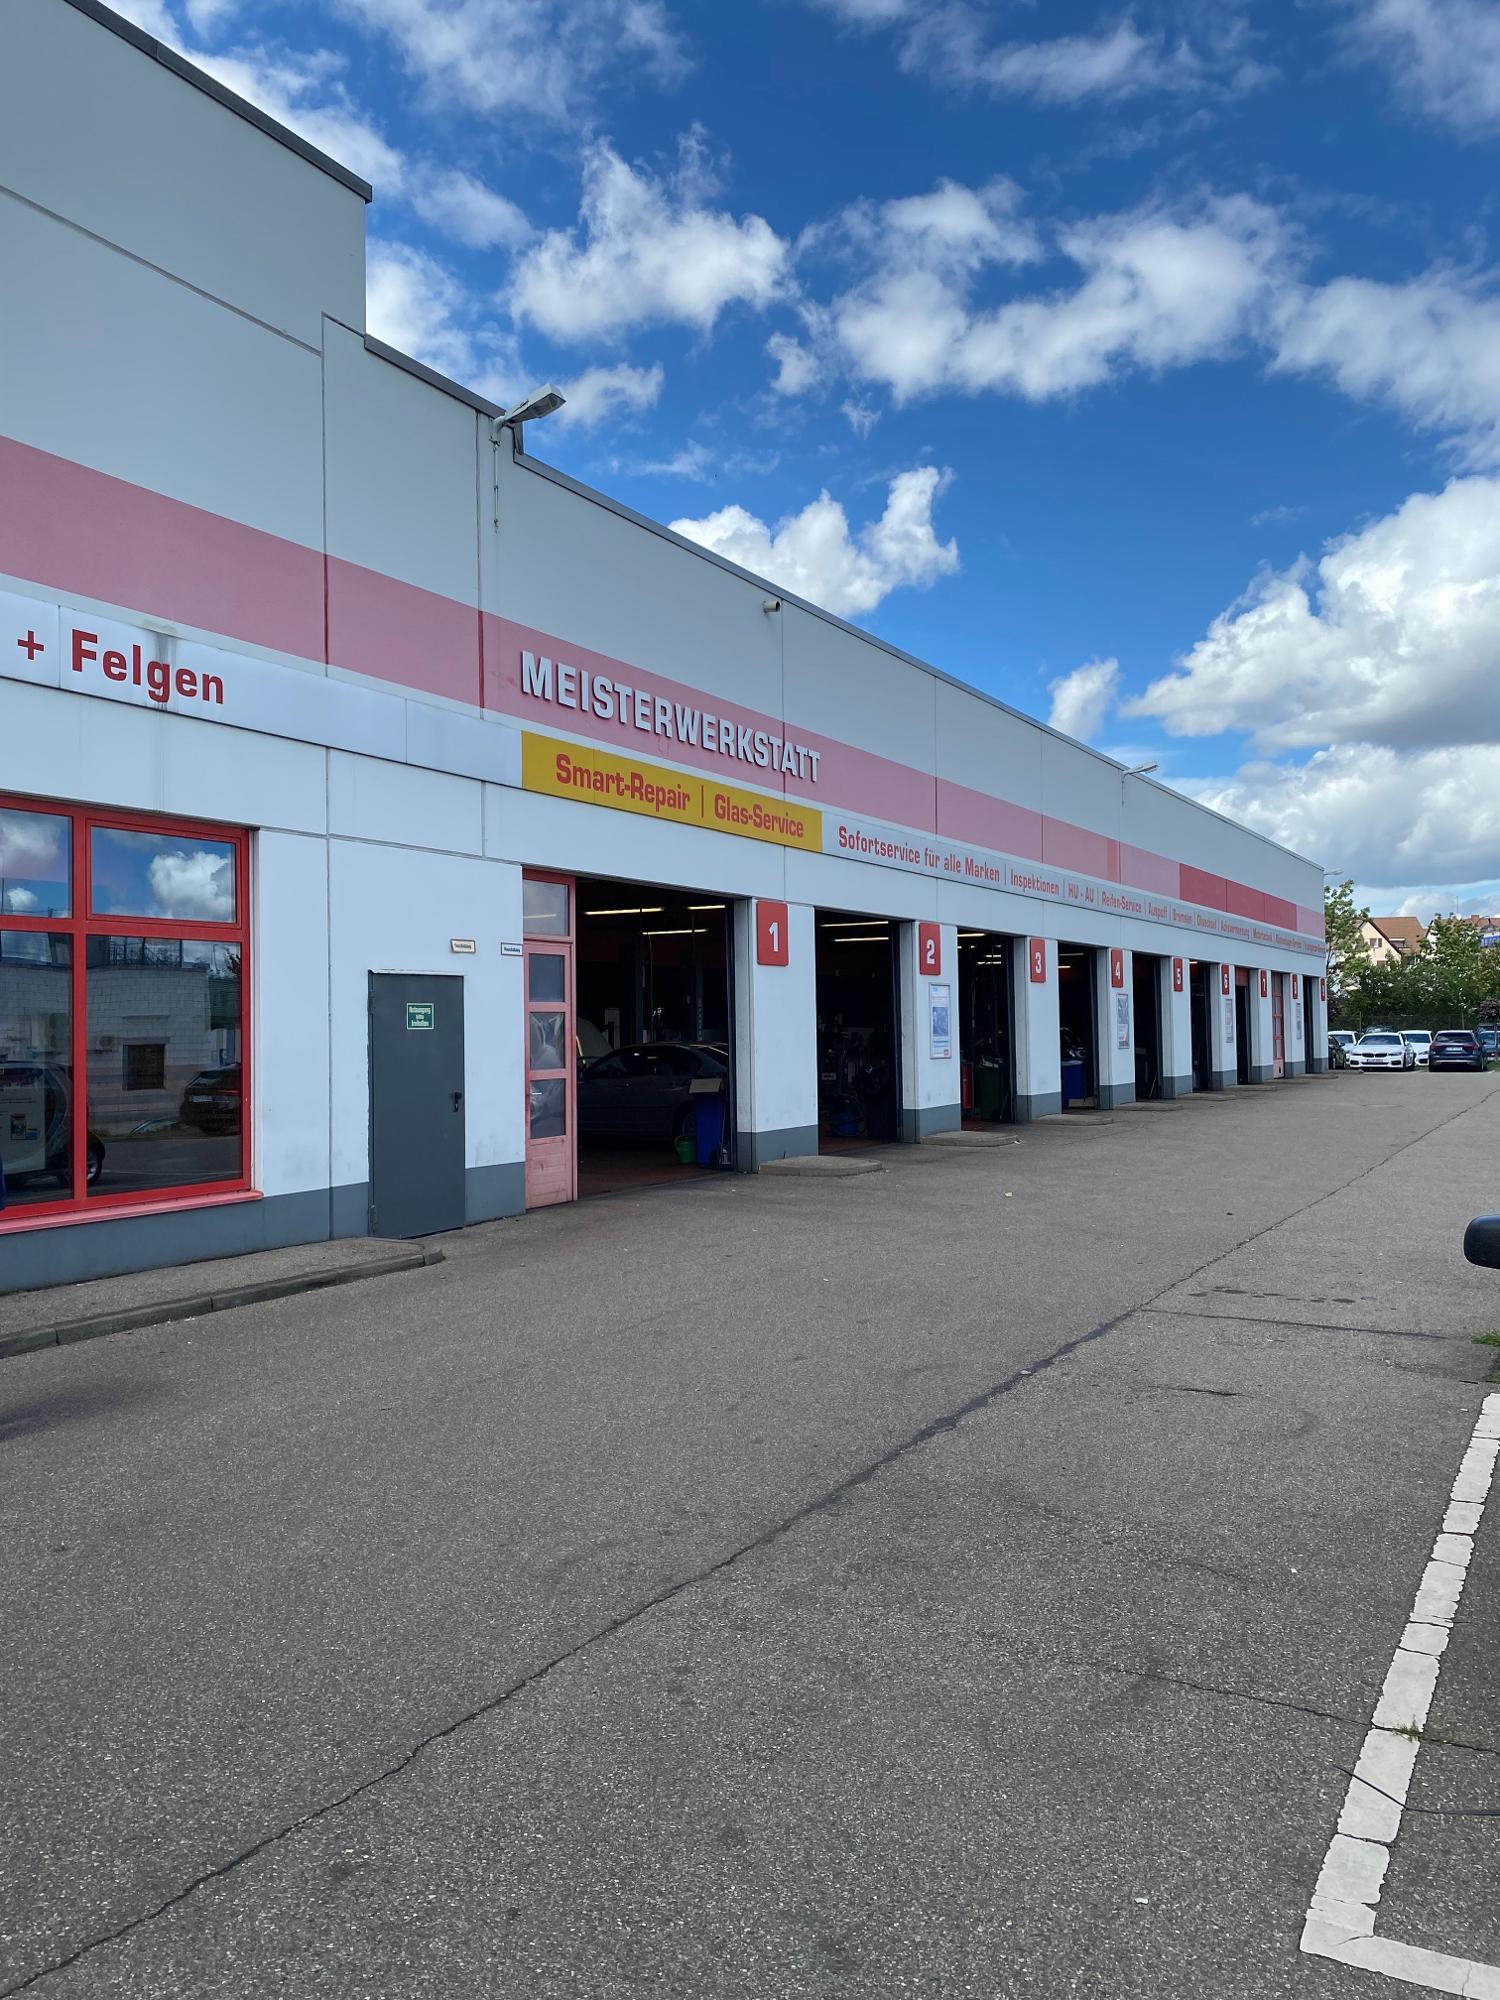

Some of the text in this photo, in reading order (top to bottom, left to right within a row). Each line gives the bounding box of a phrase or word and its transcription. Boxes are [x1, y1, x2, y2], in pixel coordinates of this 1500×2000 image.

[71, 628, 224, 705] Felgen
[521, 649, 821, 783] MEISTERWERKSTATT
[555, 753, 804, 839] Smart-Repair Glas-Service
[838, 825, 921, 865] Sofortservice
[924, 847, 941, 869] für
[944, 852, 961, 874] alle
[965, 856, 1000, 883] Marken
[1010, 868, 1059, 897] Inspektionen
[1068, 882, 1078, 899] HU
[1085, 886, 1094, 903] AU
[1102, 891, 1142, 914] Reifen-Service
[768, 921, 780, 953] 1
[926, 938, 936, 965] 2
[1034, 951, 1042, 974] 3
[1114, 961, 1122, 980] 4
[1176, 967, 1182, 985] 5
[1223, 973, 1228, 989] 6
